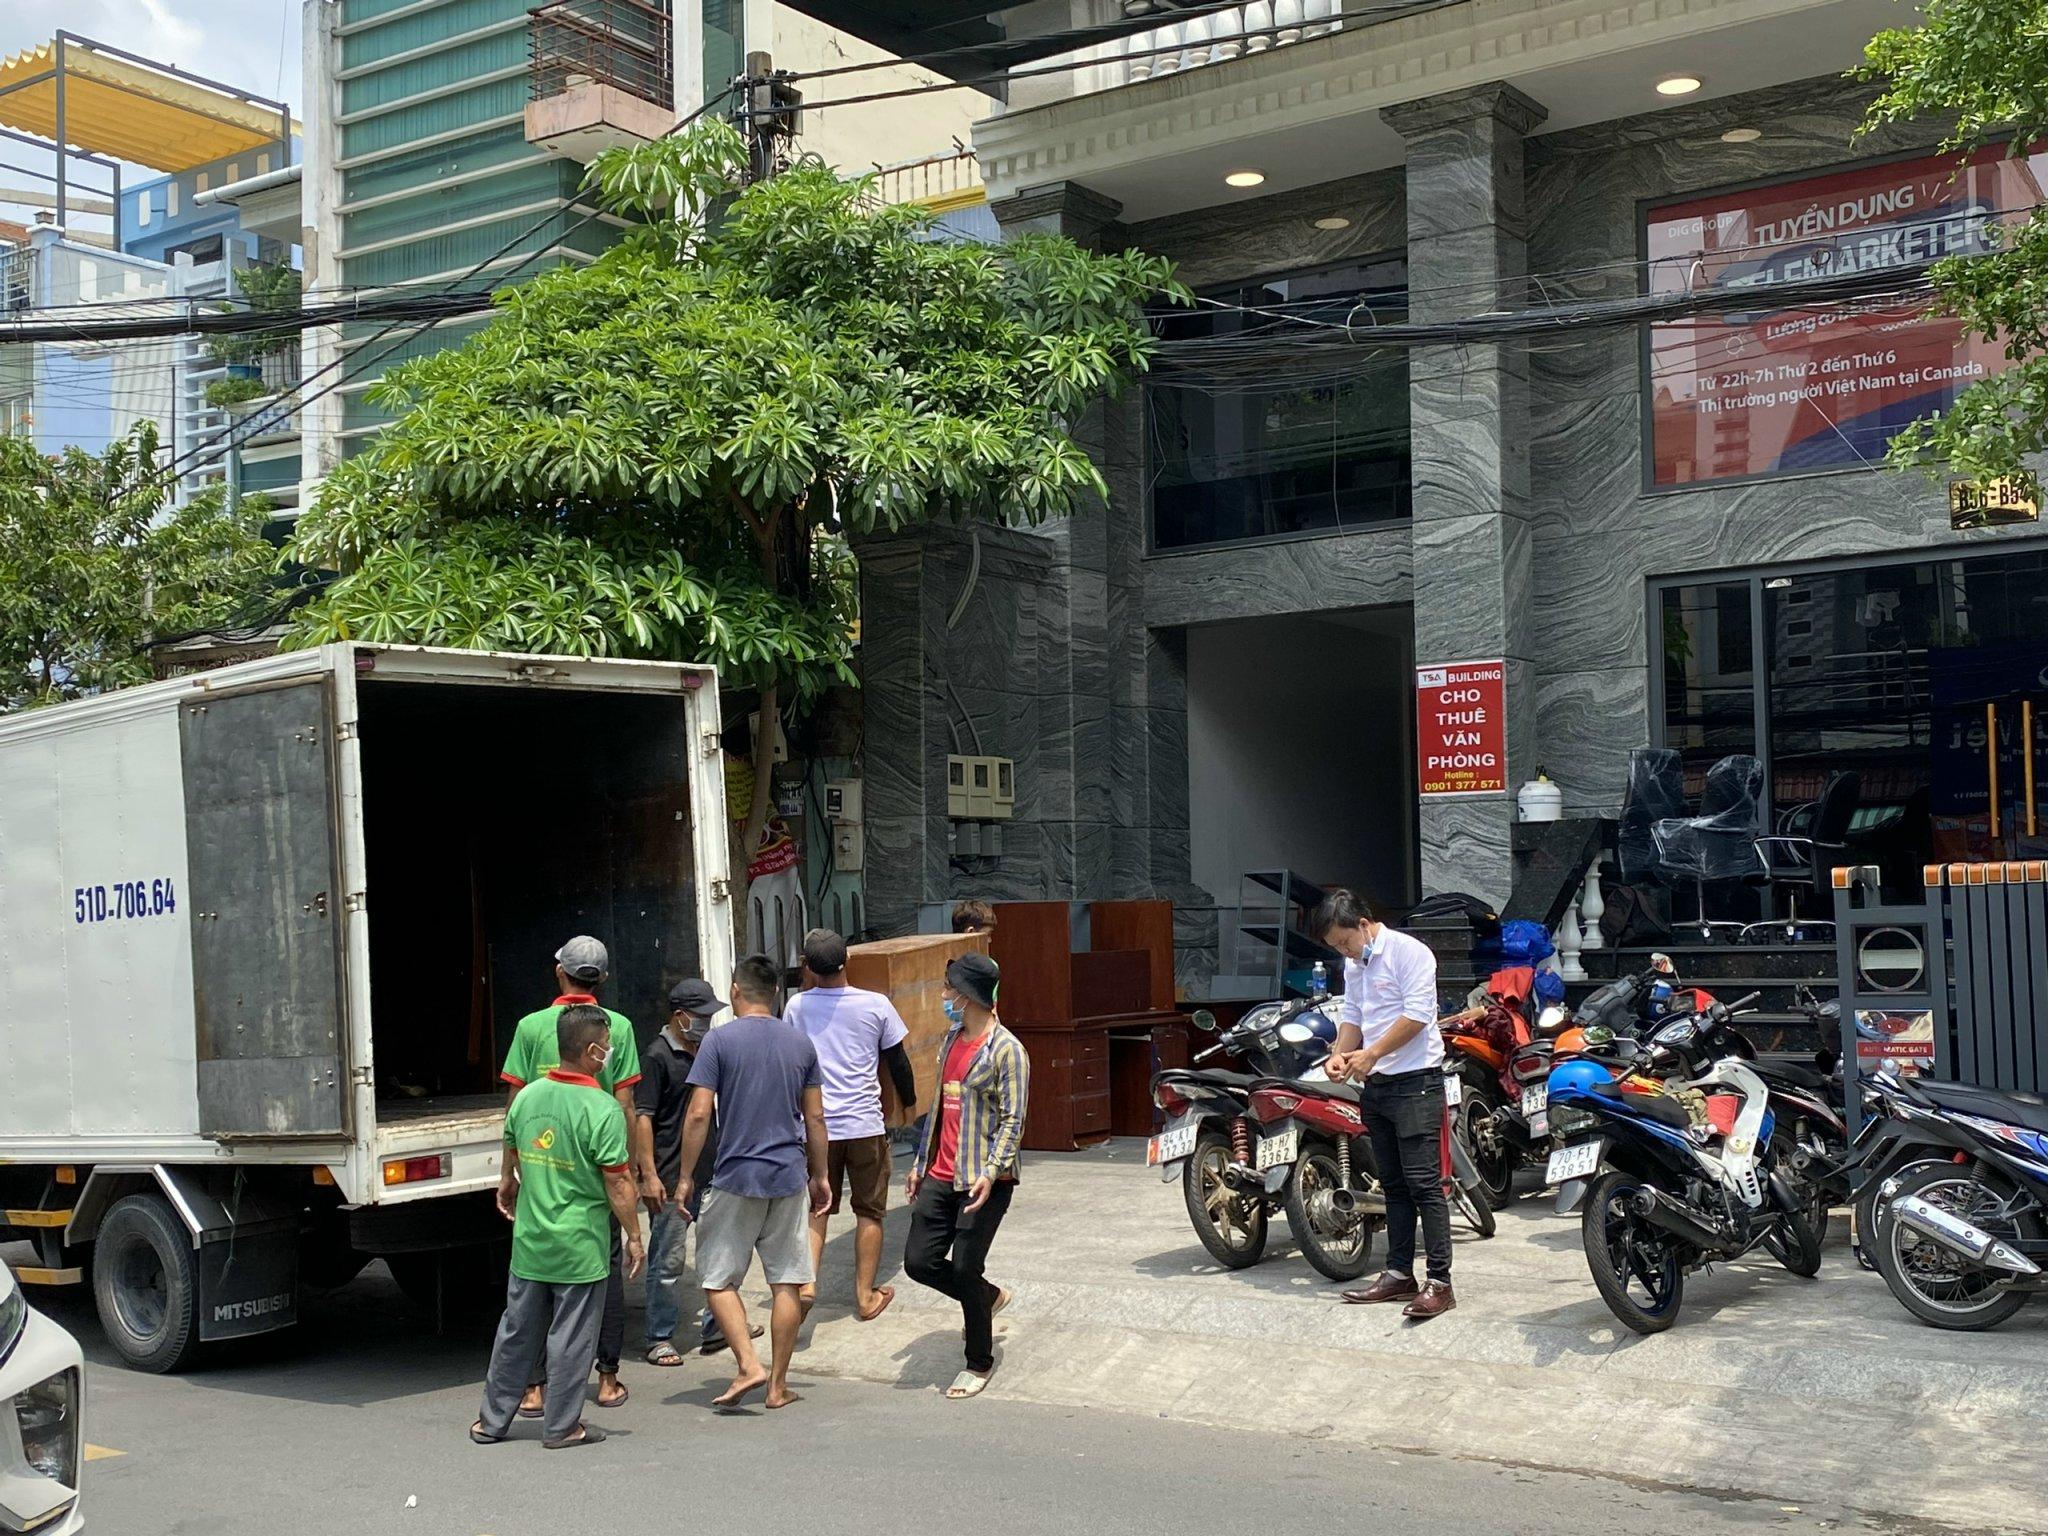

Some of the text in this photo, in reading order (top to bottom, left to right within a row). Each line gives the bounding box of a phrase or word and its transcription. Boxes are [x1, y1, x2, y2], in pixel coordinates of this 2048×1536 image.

[1754, 184, 1915, 246] TUYỂN DỤNG
[1668, 216, 1734, 239] DIG GROUP
[1699, 349, 1897, 392] Từ 22h-7h Thứ 2 đến Thứ 6
[1699, 359, 1984, 415] Thị trường người Việt Nam tại Canada
[1422, 669, 1502, 683] TSA BUILDING
[1439, 688, 1482, 705] CHO
[1435, 706, 1487, 726] THUÊ
[1441, 730, 1482, 747] VĂN
[1427, 751, 1497, 770] PHÒNG
[1444, 770, 1475, 780] Hotline
[1424, 779, 1501, 792] 0901 377 571
[1908, 1046, 1928, 1054] GATE
[1260, 1147, 1291, 1167] 3362
[1557, 1145, 1591, 1166] 70-F1
